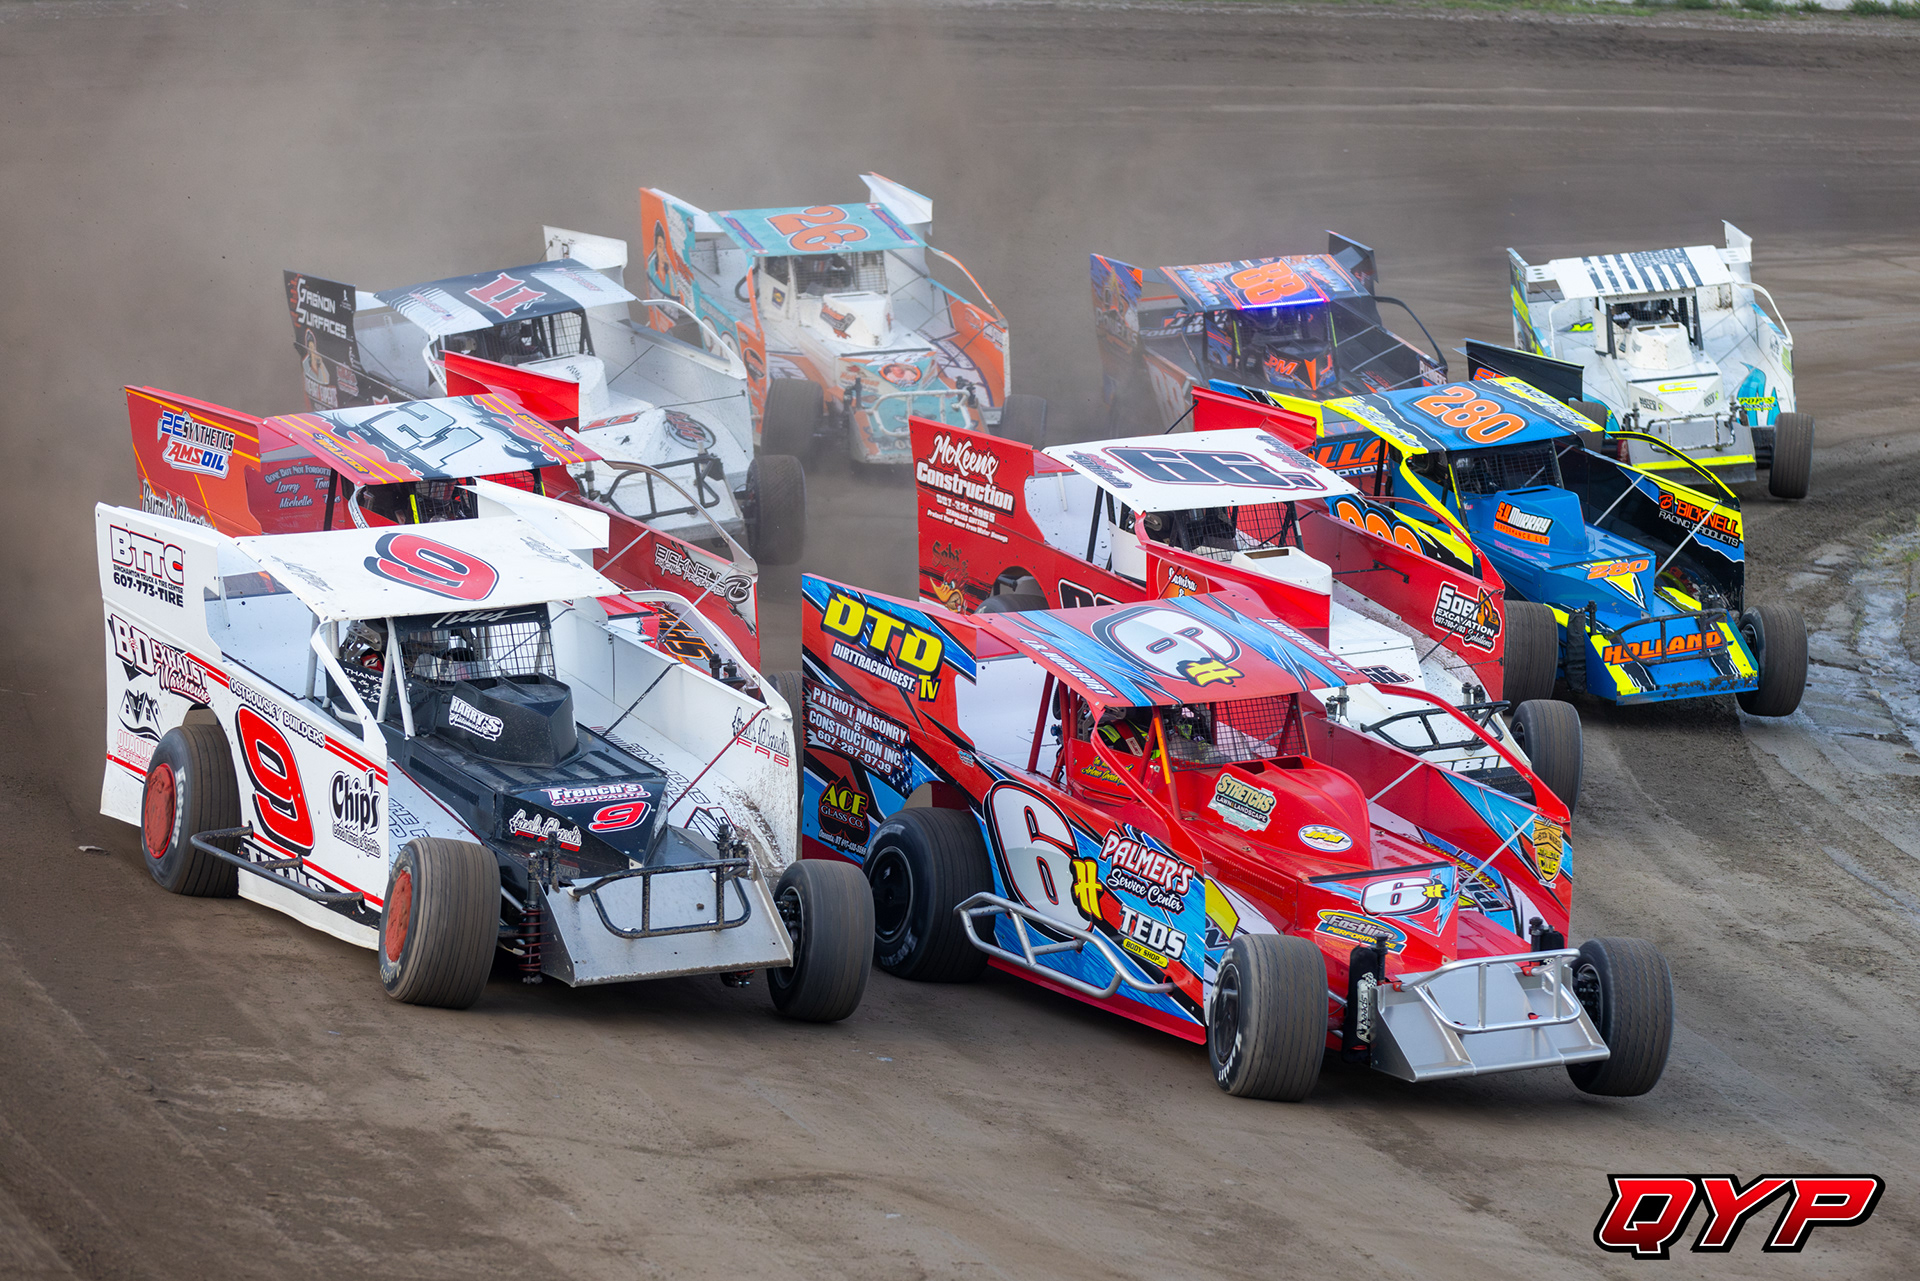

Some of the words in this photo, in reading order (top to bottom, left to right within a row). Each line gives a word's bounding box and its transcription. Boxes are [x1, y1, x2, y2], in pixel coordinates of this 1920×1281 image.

[765, 205, 870, 251] 26
[1230, 260, 1307, 305] 88
[296, 308, 347, 339] SURFACES
[161, 411, 185, 436] 2E
[183, 421, 235, 451] SYNTHETICS
[1413, 385, 1526, 444] 280
[366, 401, 484, 469] 21
[168, 441, 225, 471] AMSOIL
[928, 435, 999, 484] McKeen's
[279, 495, 313, 509] Michelle
[916, 462, 1014, 511] Construction
[1659, 511, 1691, 529] RACING
[1691, 522, 1739, 547] PRODUCTS
[1676, 500, 1740, 538] BICKNELL
[110, 524, 184, 586] BTTC
[364, 531, 501, 601] 9
[1587, 559, 1650, 580] 280
[113, 571, 184, 608] 607-773-TIRE
[1438, 586, 1480, 621] SOBI
[823, 593, 943, 673] DTD
[1436, 607, 1495, 637] EXCAVATION
[150, 638, 208, 689] EXHAUST
[1602, 630, 1725, 666] HOLLAND
[155, 663, 211, 704] Warehouse
[833, 642, 915, 692] DIRTTRACKDIGEST.
[918, 674, 939, 699] TV
[229, 677, 282, 721] OSTROWSKY
[283, 711, 326, 748] BUILDERS
[450, 697, 502, 734] HARRY'S
[813, 687, 855, 718] PATRIOT
[856, 708, 907, 744] MASONRY
[854, 721, 862, 732] &
[809, 710, 882, 758] CONSTRUCTION
[884, 747, 904, 769] INC.
[236, 703, 315, 857] 9
[548, 783, 641, 801] French's
[1217, 775, 1274, 812] STRETCHS
[332, 771, 380, 832] Chip's
[589, 801, 651, 833] 9
[820, 805, 848, 823] GLASS
[848, 815, 865, 829] CO.
[822, 785, 866, 817] ACE
[1234, 803, 1267, 822] LANDSCAPE
[1305, 830, 1345, 844] JPM
[1100, 831, 1194, 894] PALMER'S
[1107, 868, 1147, 896] Service
[1147, 886, 1183, 912] Center
[1124, 940, 1143, 954] BODY
[1143, 948, 1160, 963] SHOP
[1326, 926, 1397, 950] PERFORMACE
